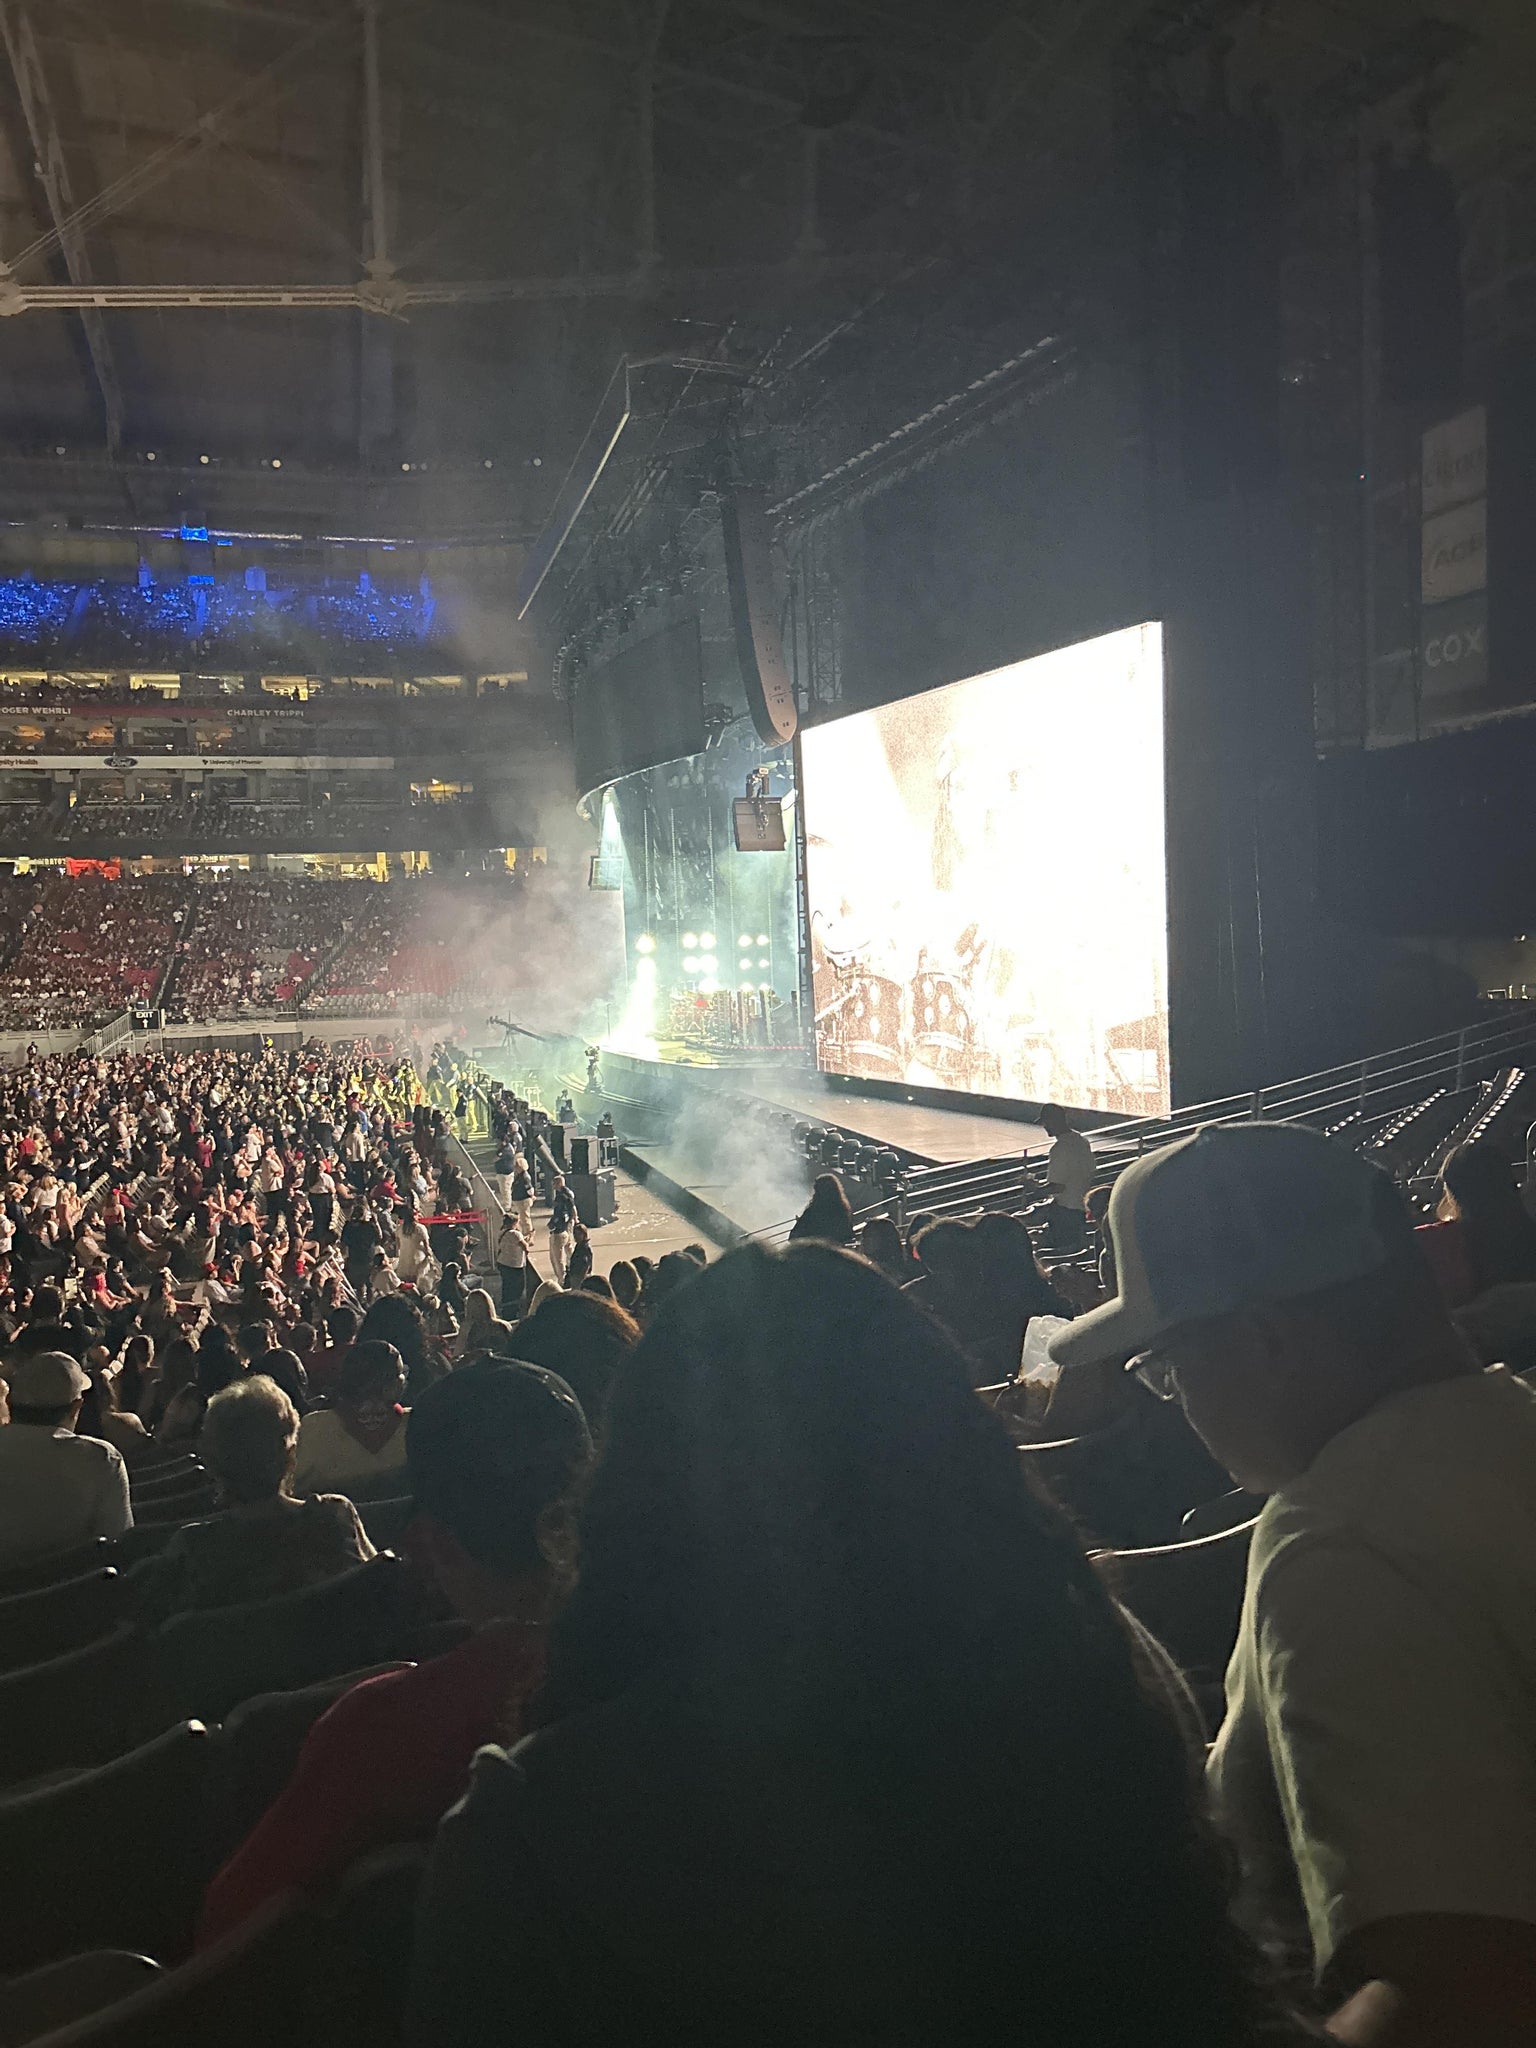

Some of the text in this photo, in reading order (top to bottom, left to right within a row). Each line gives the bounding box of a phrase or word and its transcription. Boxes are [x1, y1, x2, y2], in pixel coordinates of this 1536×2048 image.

[1425, 628, 1484, 667] COX
[0, 706, 71, 715] OGER WEHRLI
[227, 709, 271, 717] CHARLEY
